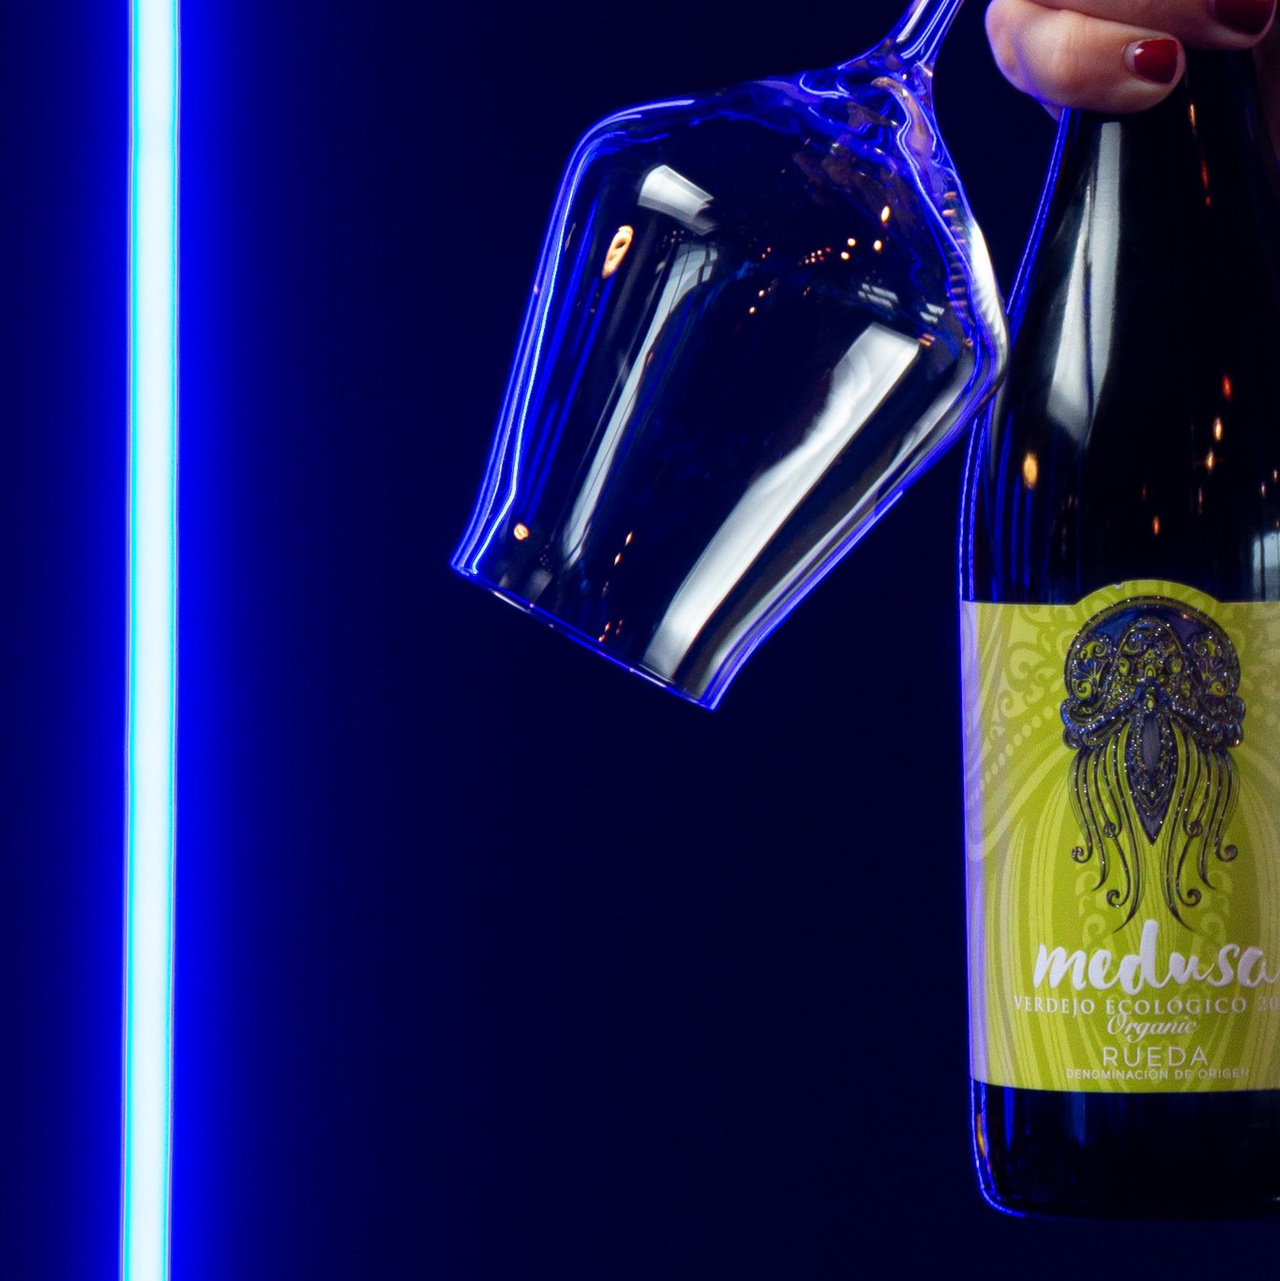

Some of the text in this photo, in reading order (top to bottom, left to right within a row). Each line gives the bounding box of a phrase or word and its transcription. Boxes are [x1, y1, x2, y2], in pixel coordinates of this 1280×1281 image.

[1013, 994, 1095, 1016] VERDEJO
[1105, 994, 1247, 1016] ECOLÓGICO
[1106, 1010, 1198, 1042] Organic
[1102, 1046, 1208, 1067] RUEDA
[1066, 1067, 1250, 1080] DENOMINACIÓN DE ORIGEN
